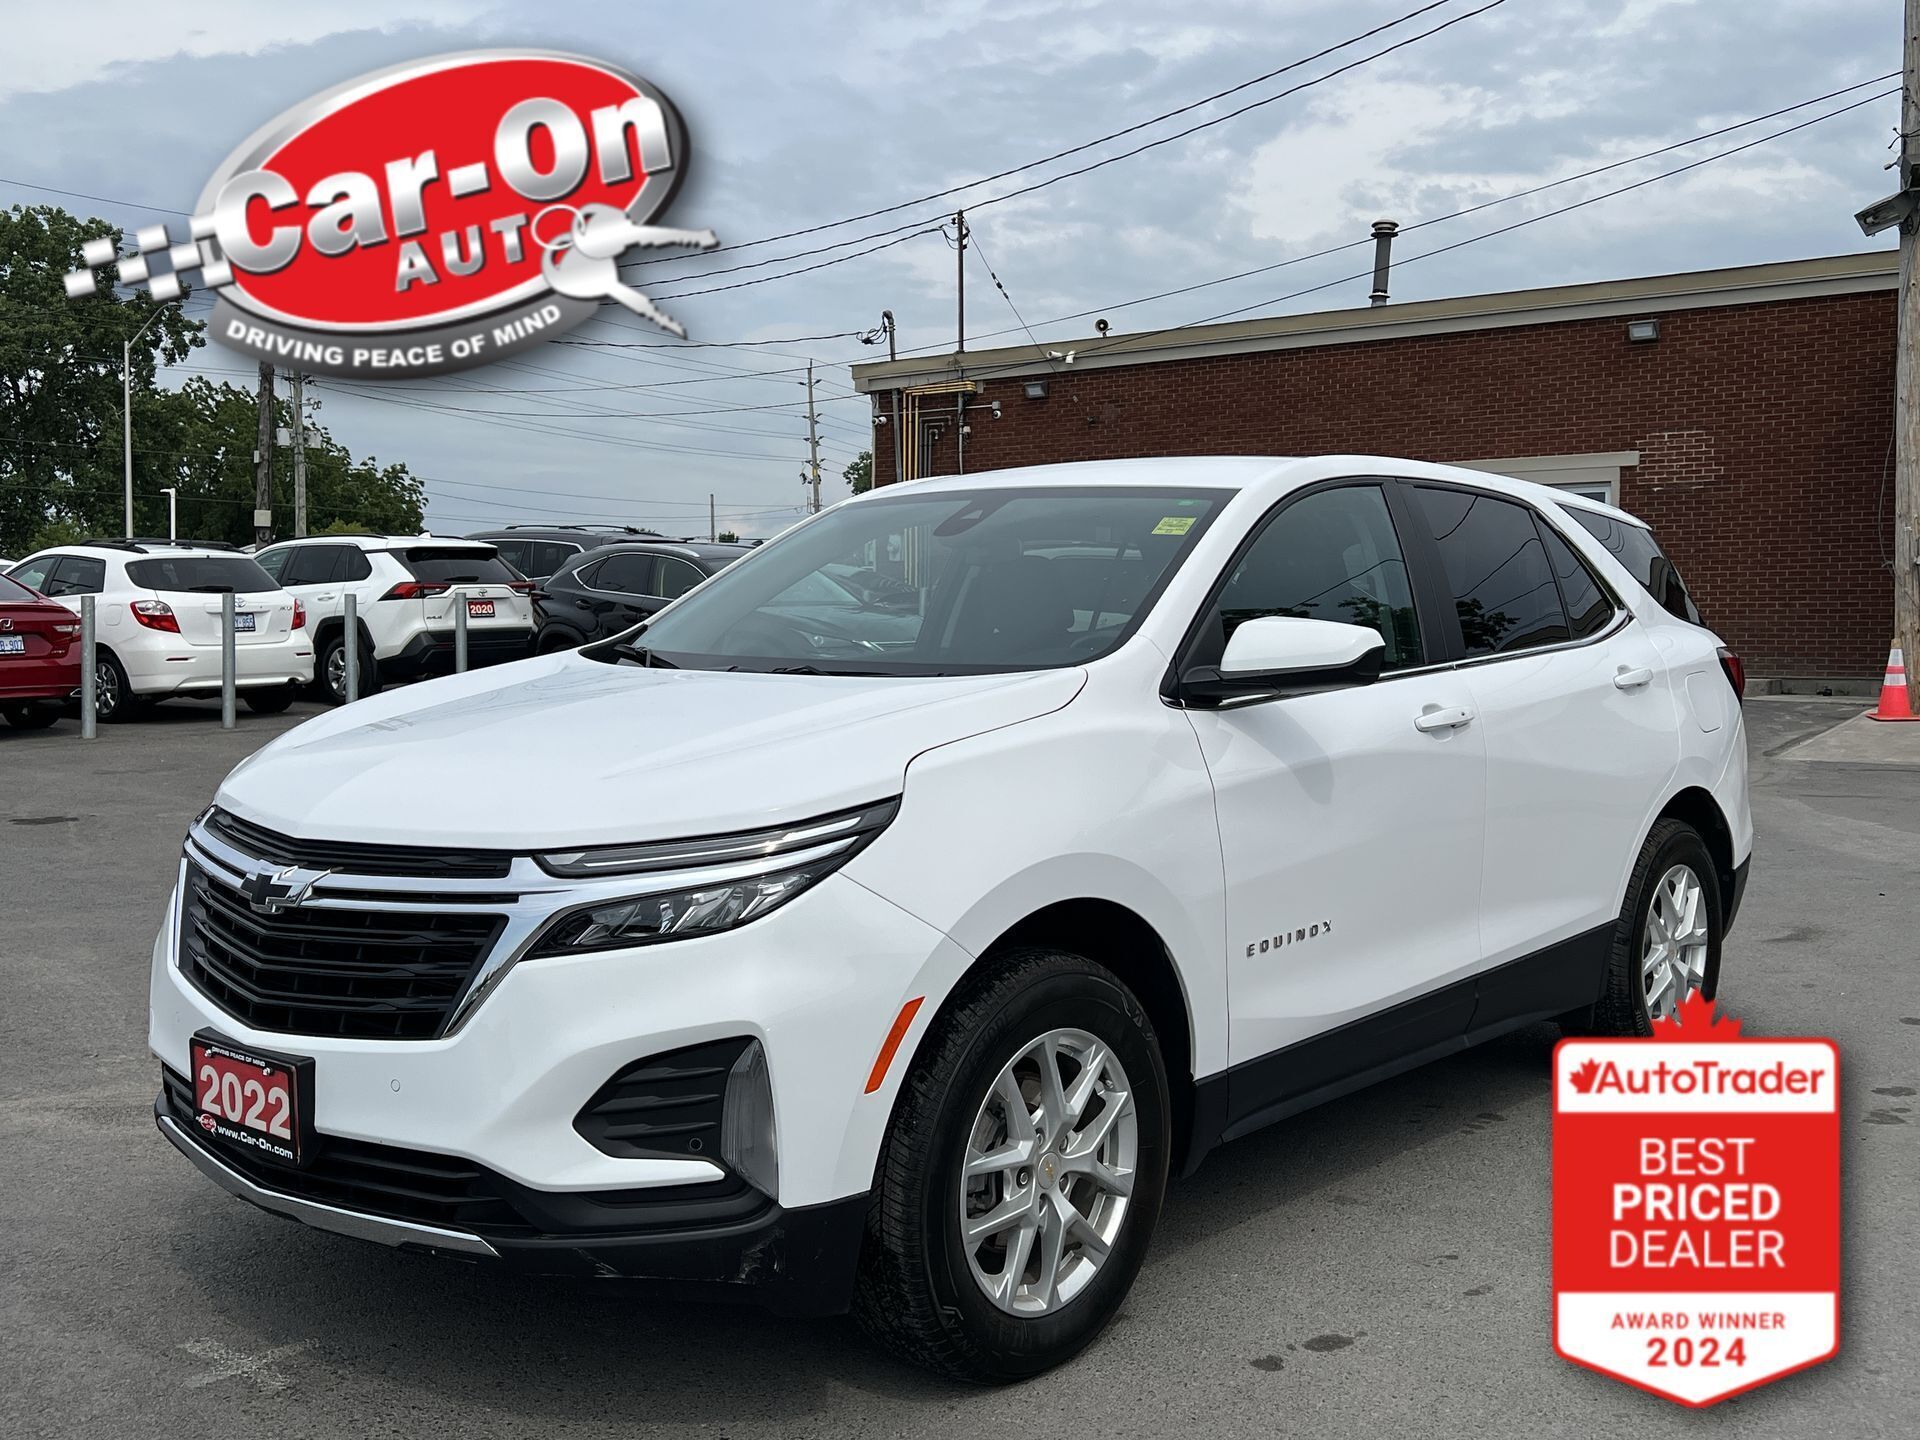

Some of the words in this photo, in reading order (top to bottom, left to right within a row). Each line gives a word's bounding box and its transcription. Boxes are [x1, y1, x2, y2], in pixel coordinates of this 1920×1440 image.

[470, 604, 493, 614] 2020
[1246, 920, 1332, 958] EQUINOX
[200, 1064, 291, 1140] 2022
[217, 1124, 293, 1160] www.Car-On.com
